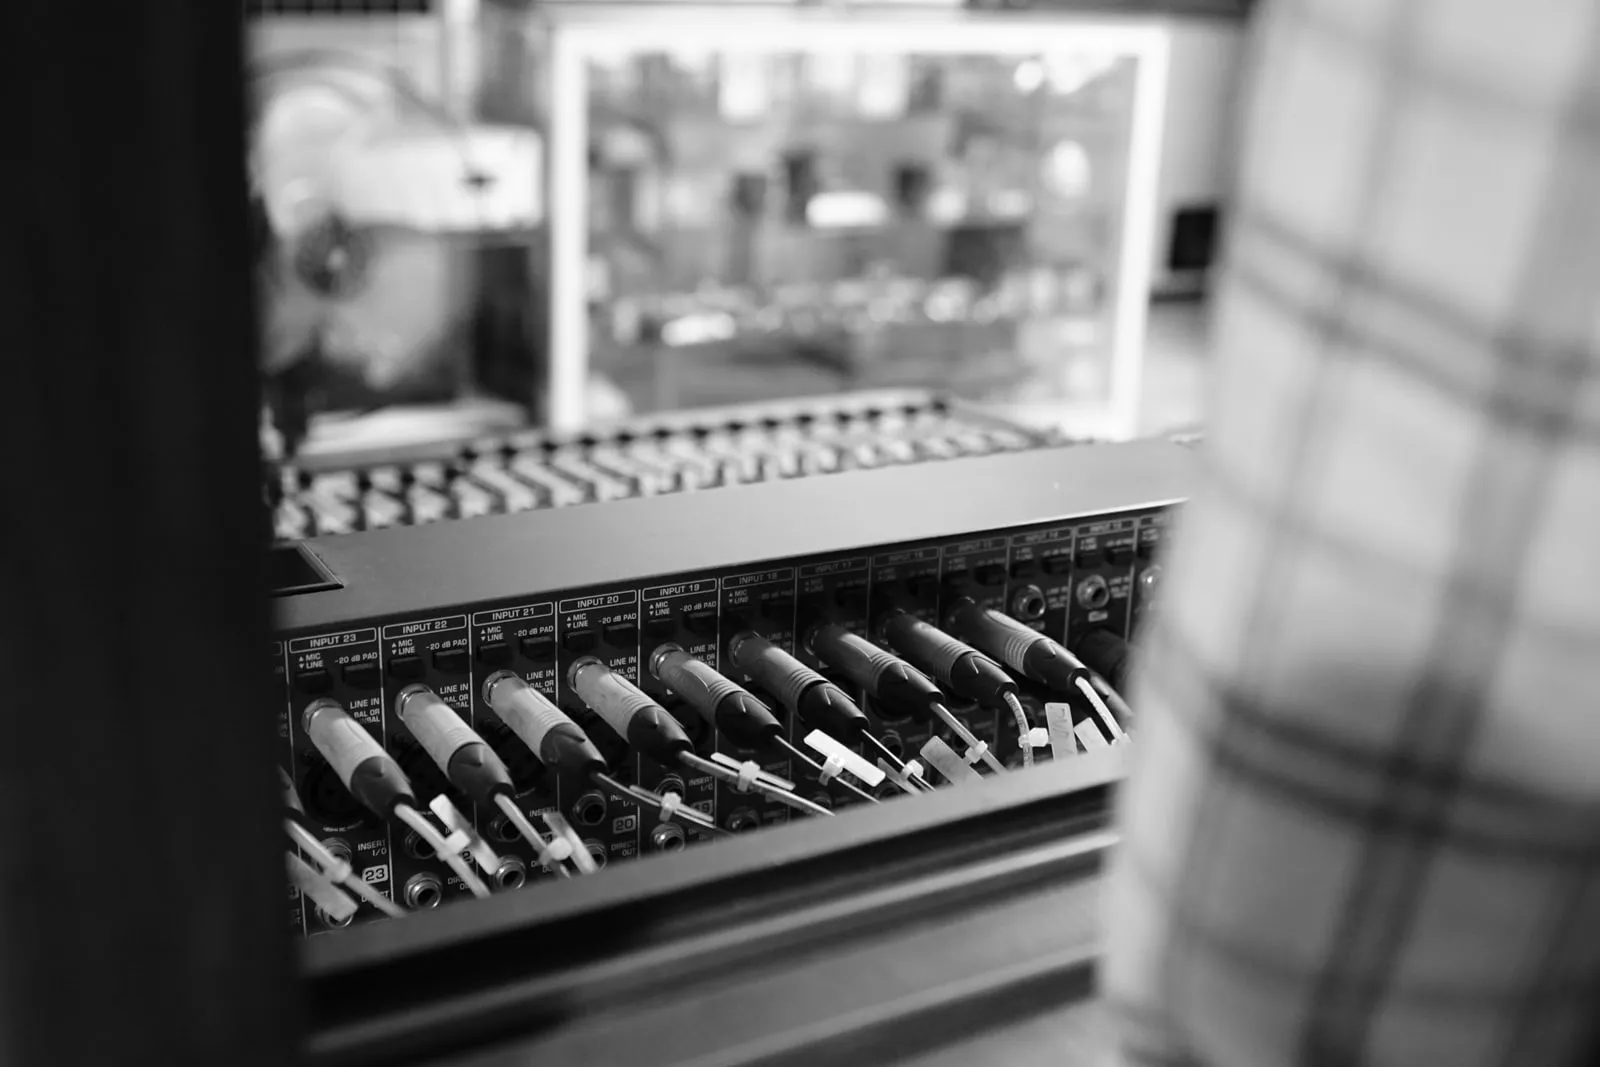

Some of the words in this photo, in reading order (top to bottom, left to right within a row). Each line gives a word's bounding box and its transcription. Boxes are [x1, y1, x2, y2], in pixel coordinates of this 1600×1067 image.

[739, 574, 763, 584] INPUT
[660, 586, 686, 596] INPUT
[688, 584, 700, 592] 19
[577, 598, 604, 609] INPUT
[606, 596, 619, 604] 20
[492, 610, 520, 620] INPUT
[523, 608, 534, 616] 21
[656, 608, 670, 616] LINE
[403, 623, 431, 634] INPUT
[434, 620, 447, 629] 22
[573, 620, 588, 628] LINE
[487, 626, 501, 634] MIC
[539, 626, 554, 634] PAD
[310, 636, 340, 647] INPUT
[343, 634, 356, 642] 23
[487, 633, 503, 642] LINE
[398, 639, 413, 647] MIC
[452, 638, 467, 647] PAD
[398, 646, 415, 655] LINE
[690, 645, 706, 654] LINE
[306, 652, 321, 661] MIC
[362, 652, 378, 660] PAD
[306, 660, 324, 669] LINE
[610, 658, 626, 667] LINE
[628, 656, 636, 664] IN
[626, 666, 636, 674] OR
[526, 671, 544, 681] LINE
[546, 669, 554, 677] IN
[544, 680, 554, 688] OR
[440, 685, 458, 694] LINE
[350, 698, 369, 710] LINE
[371, 697, 380, 706] IN
[369, 708, 380, 716] OR
[688, 776, 713, 786] INSERT
[616, 819, 634, 831] 20
[357, 840, 386, 851] INSERT
[372, 848, 387, 856] I/O
[365, 868, 385, 882] 23
